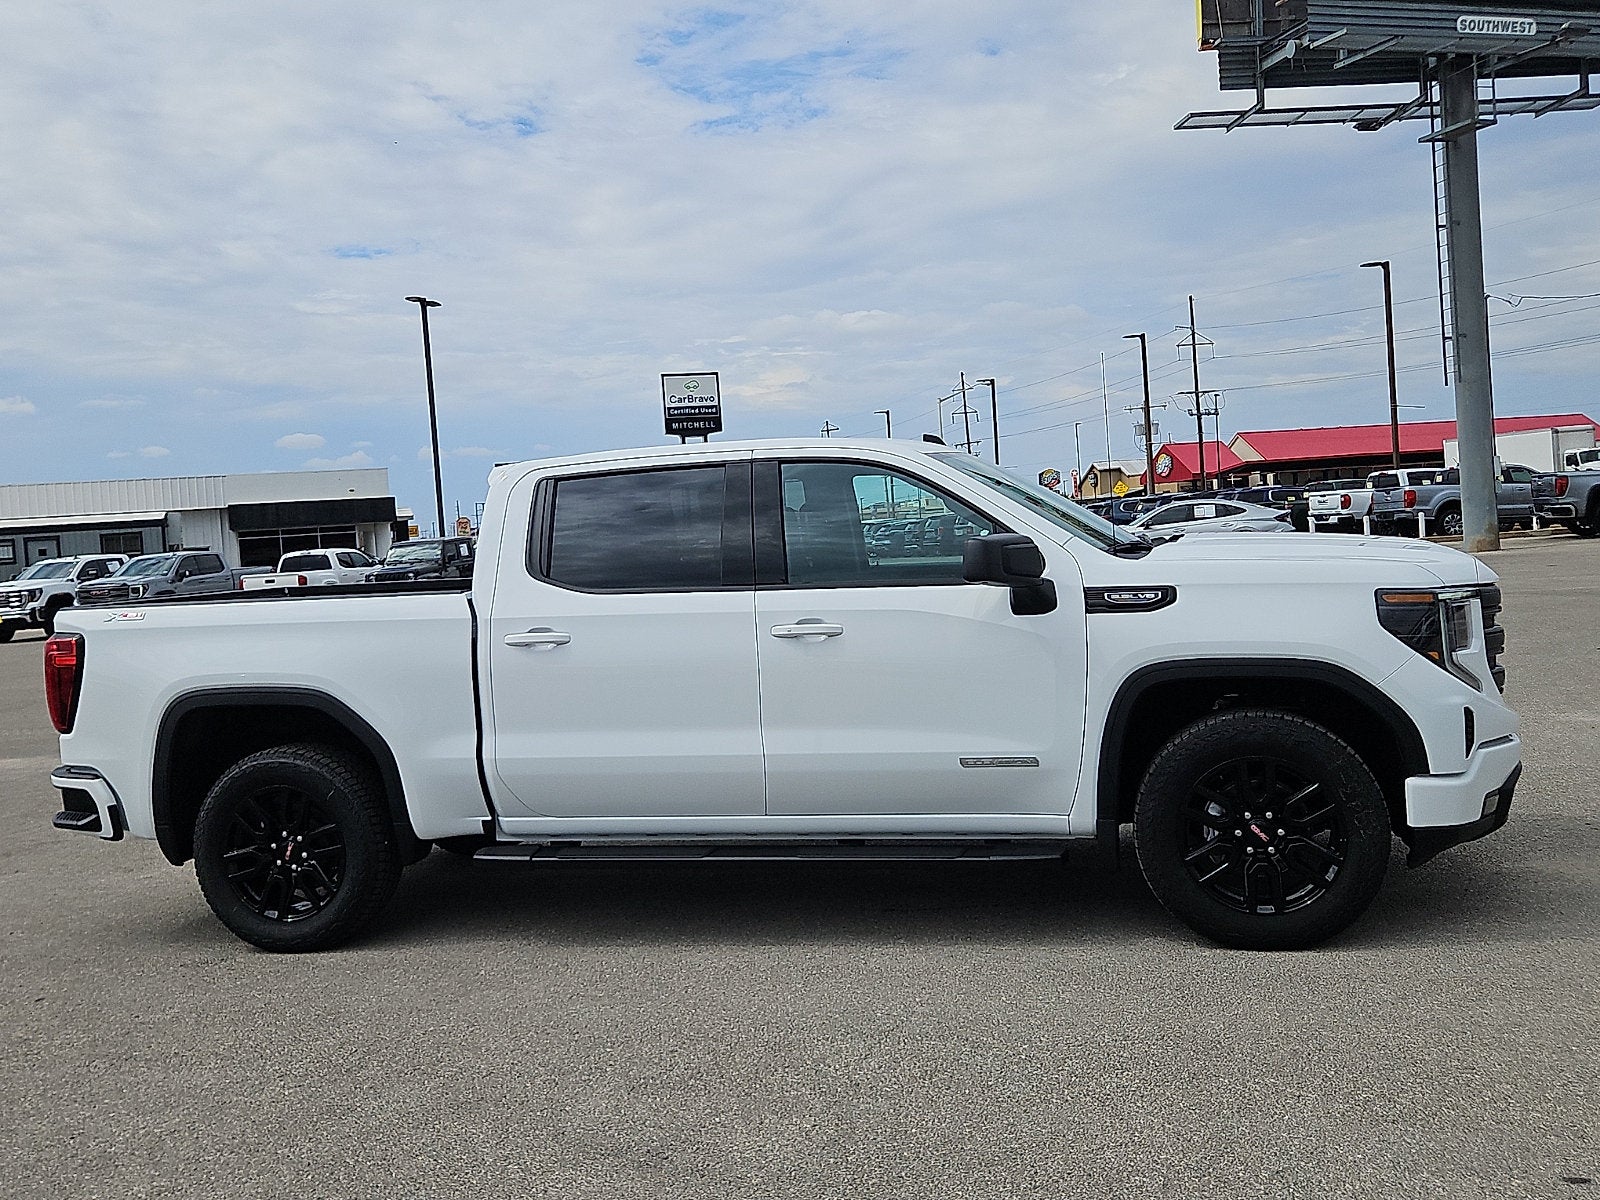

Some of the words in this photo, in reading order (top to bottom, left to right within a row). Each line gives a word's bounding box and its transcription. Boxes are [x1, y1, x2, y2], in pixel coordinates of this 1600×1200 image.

[1459, 18, 1534, 34] SOUTHWEST
[669, 394, 715, 404] CarBravo
[672, 420, 716, 429] MITCHELL
